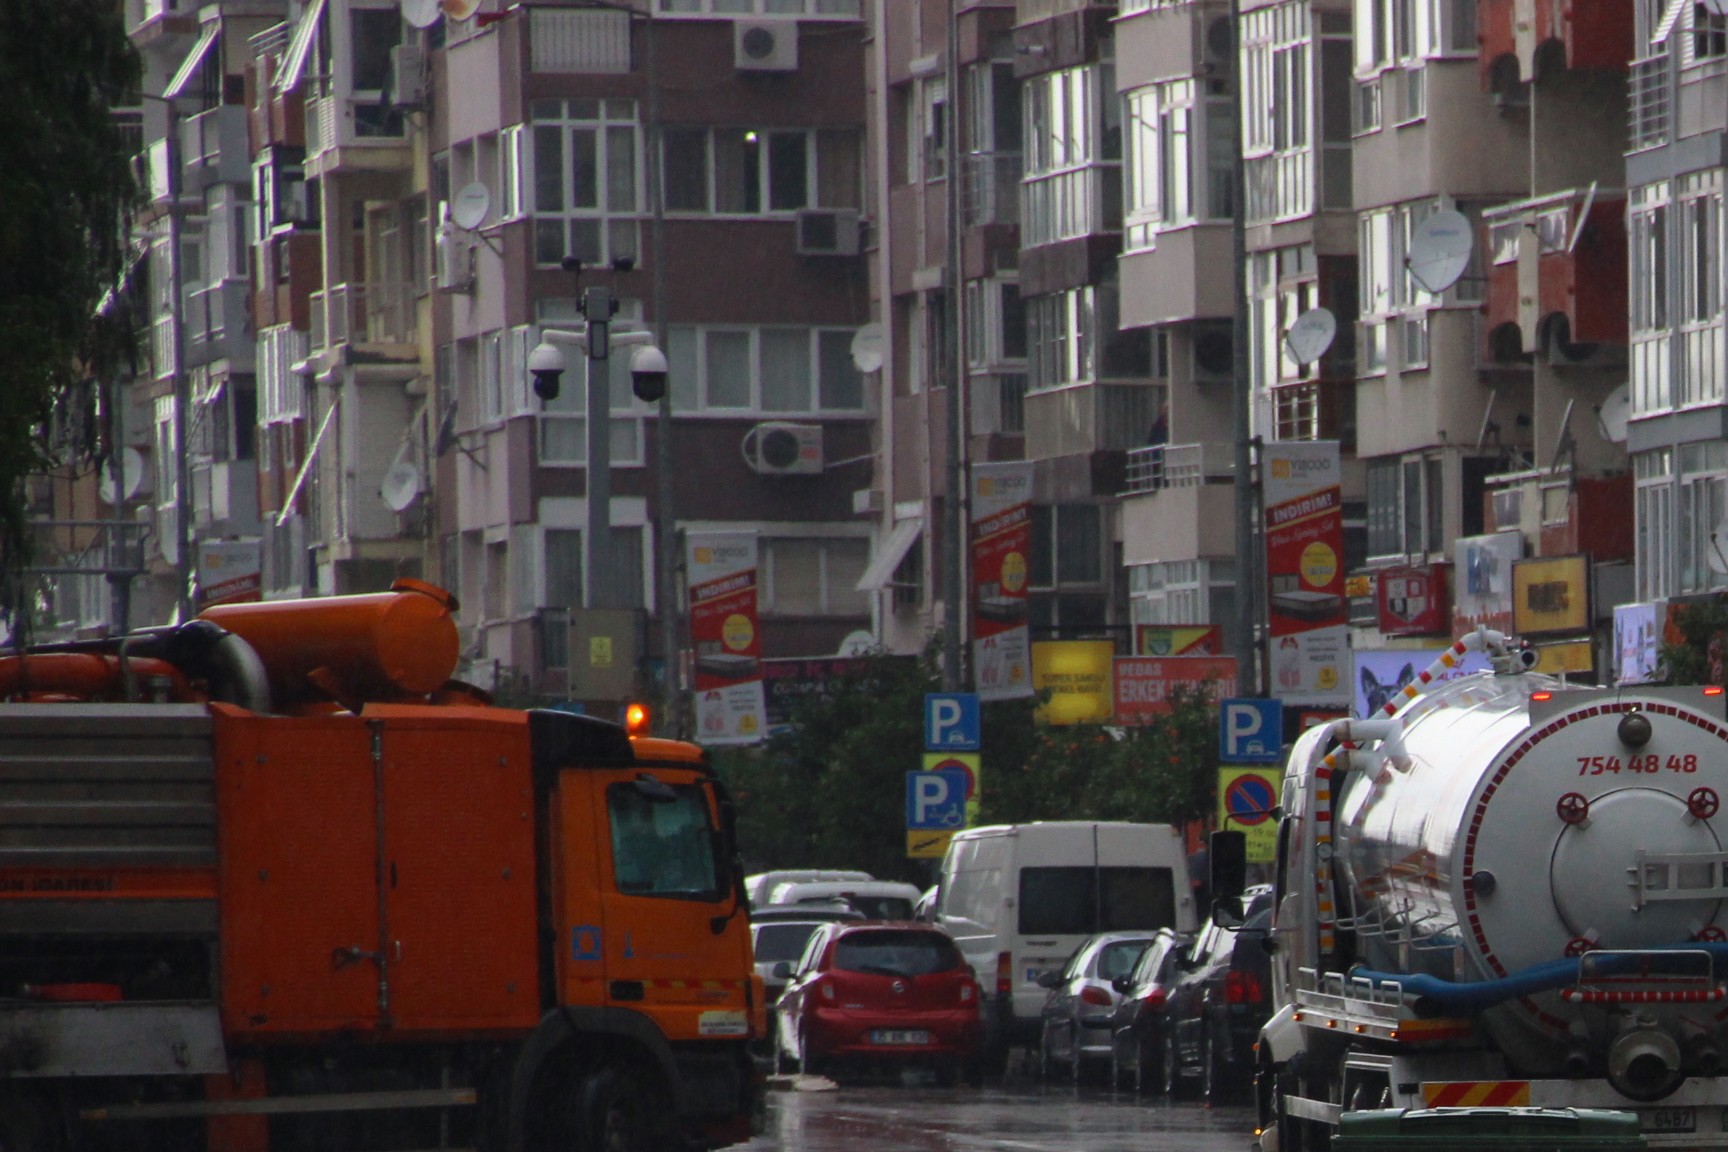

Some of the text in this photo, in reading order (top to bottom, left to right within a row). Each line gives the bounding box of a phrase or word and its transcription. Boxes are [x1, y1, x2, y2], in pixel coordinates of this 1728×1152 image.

[1119, 678, 1166, 703] ERKEK
[931, 699, 962, 745] P
[1227, 704, 1262, 755] P
[1577, 754, 1698, 776] 754 48 48
[915, 776, 948, 823] P
[1654, 1110, 1691, 1127] 6487
